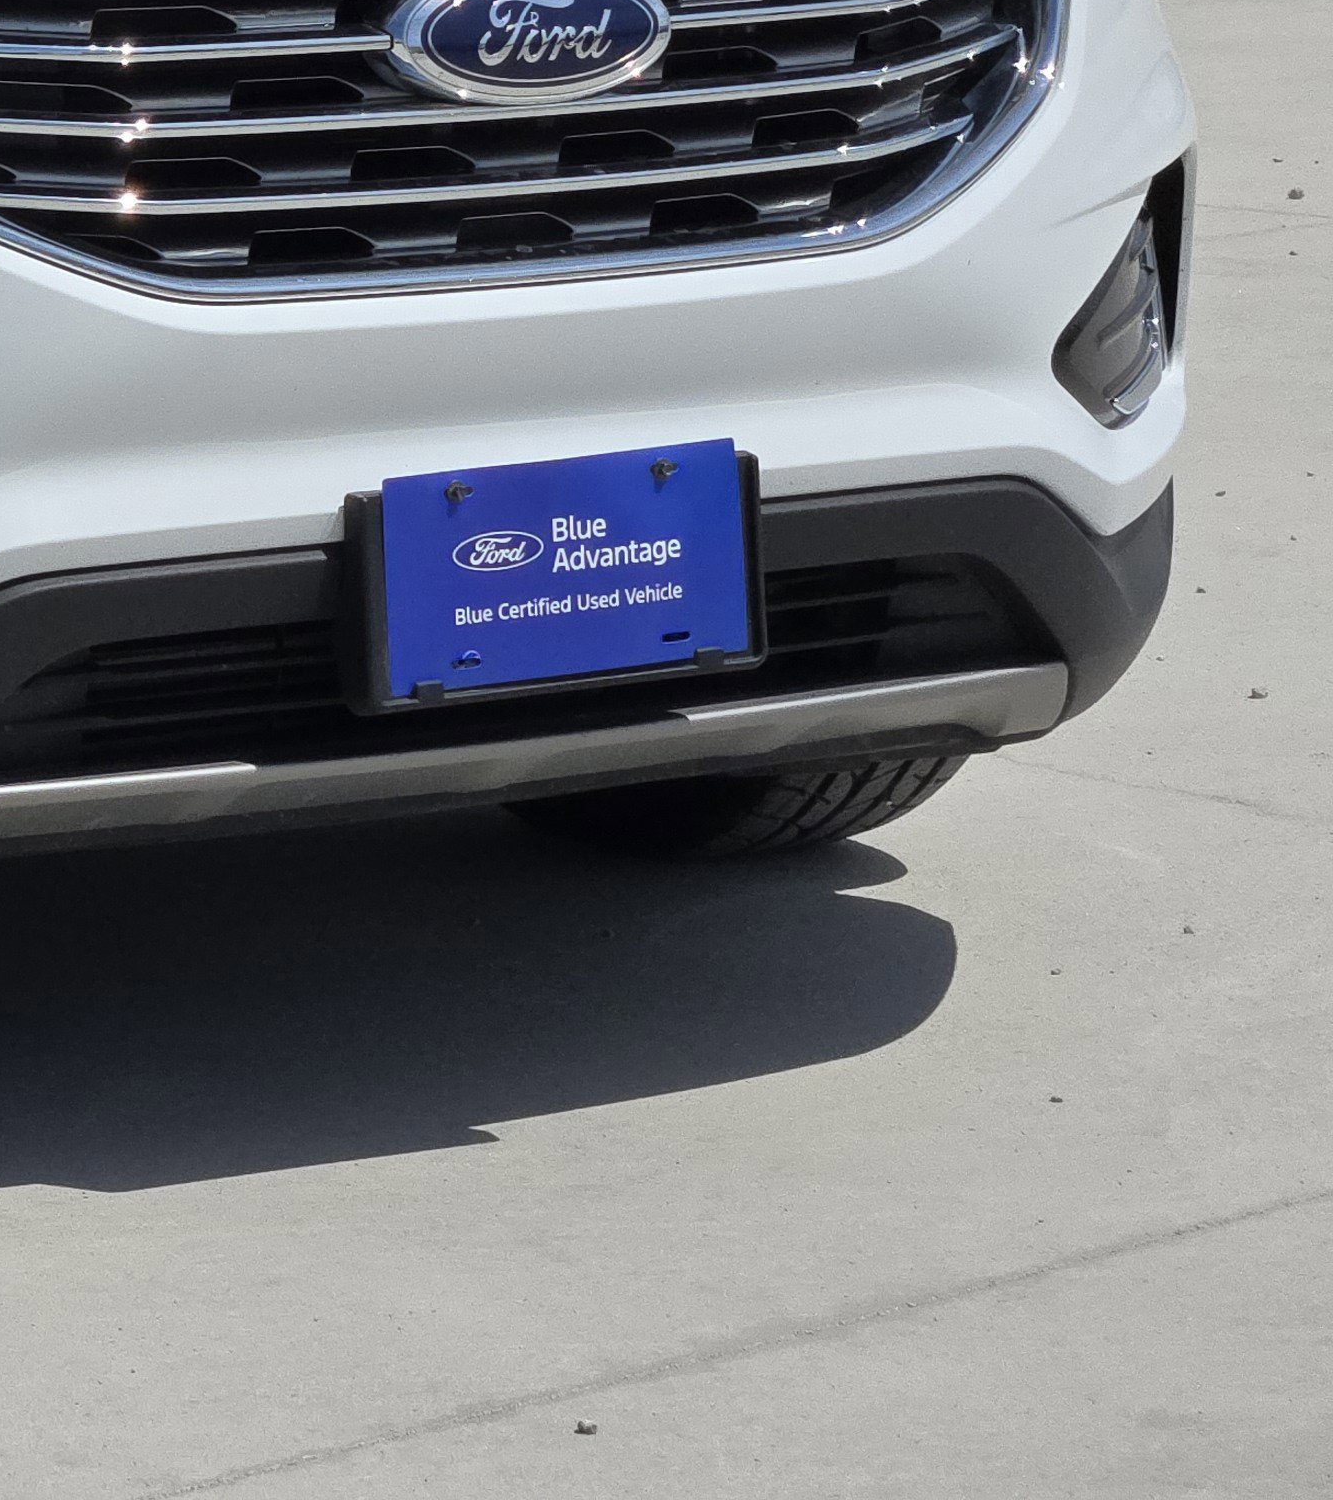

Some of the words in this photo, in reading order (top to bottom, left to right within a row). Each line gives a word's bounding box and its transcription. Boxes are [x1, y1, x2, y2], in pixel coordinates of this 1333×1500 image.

[551, 515, 607, 543] Blue
[470, 537, 526, 565] Ford
[552, 536, 682, 573] Advantage
[454, 607, 494, 626] Blue
[498, 596, 572, 621] Certified
[577, 591, 620, 612] Used
[625, 582, 684, 605] Vehicle
